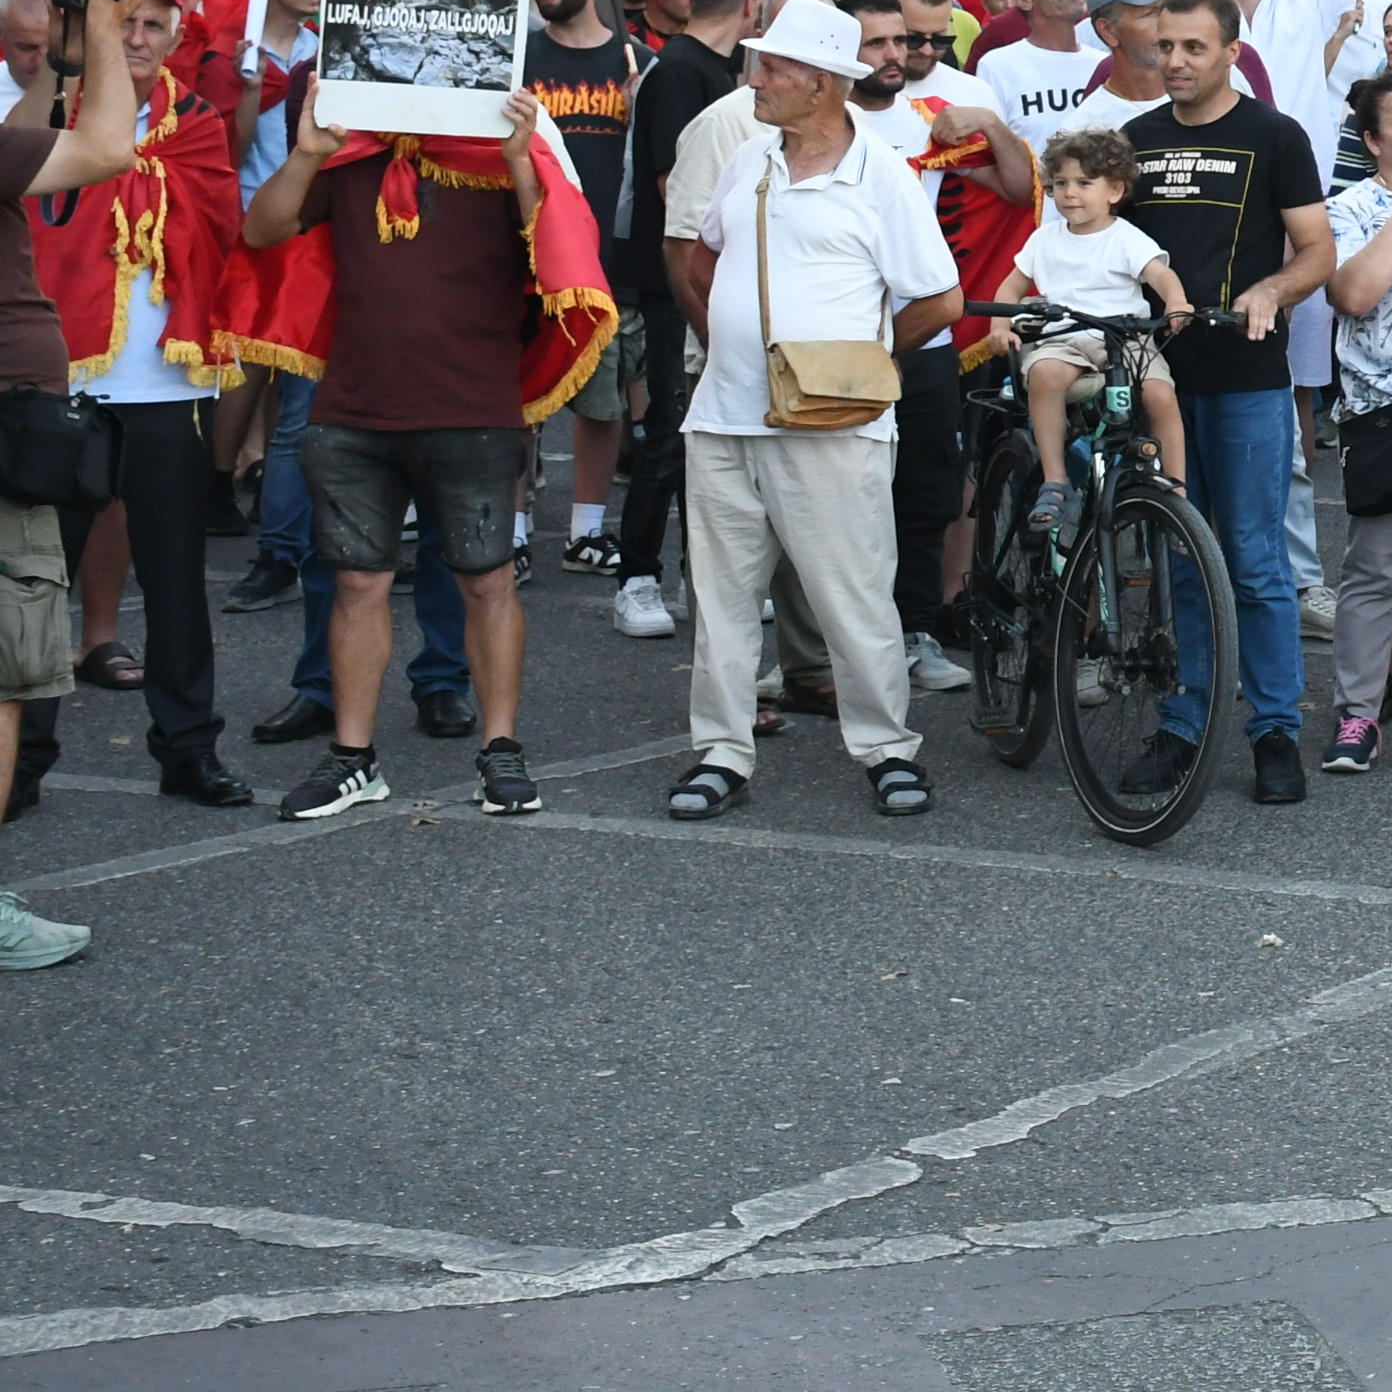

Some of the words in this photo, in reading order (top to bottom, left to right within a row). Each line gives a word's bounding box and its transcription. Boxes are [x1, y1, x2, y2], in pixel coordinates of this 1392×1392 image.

[327, 2, 371, 29] LUFAJ,
[373, 7, 427, 33] GJOQAJ,
[429, 12, 514, 39] ZALLGJOQAJ
[1167, 158, 1196, 172] RAW
[1195, 158, 1237, 174] DENIM
[1165, 172, 1192, 184] 3103
[1115, 390, 1130, 408] S
